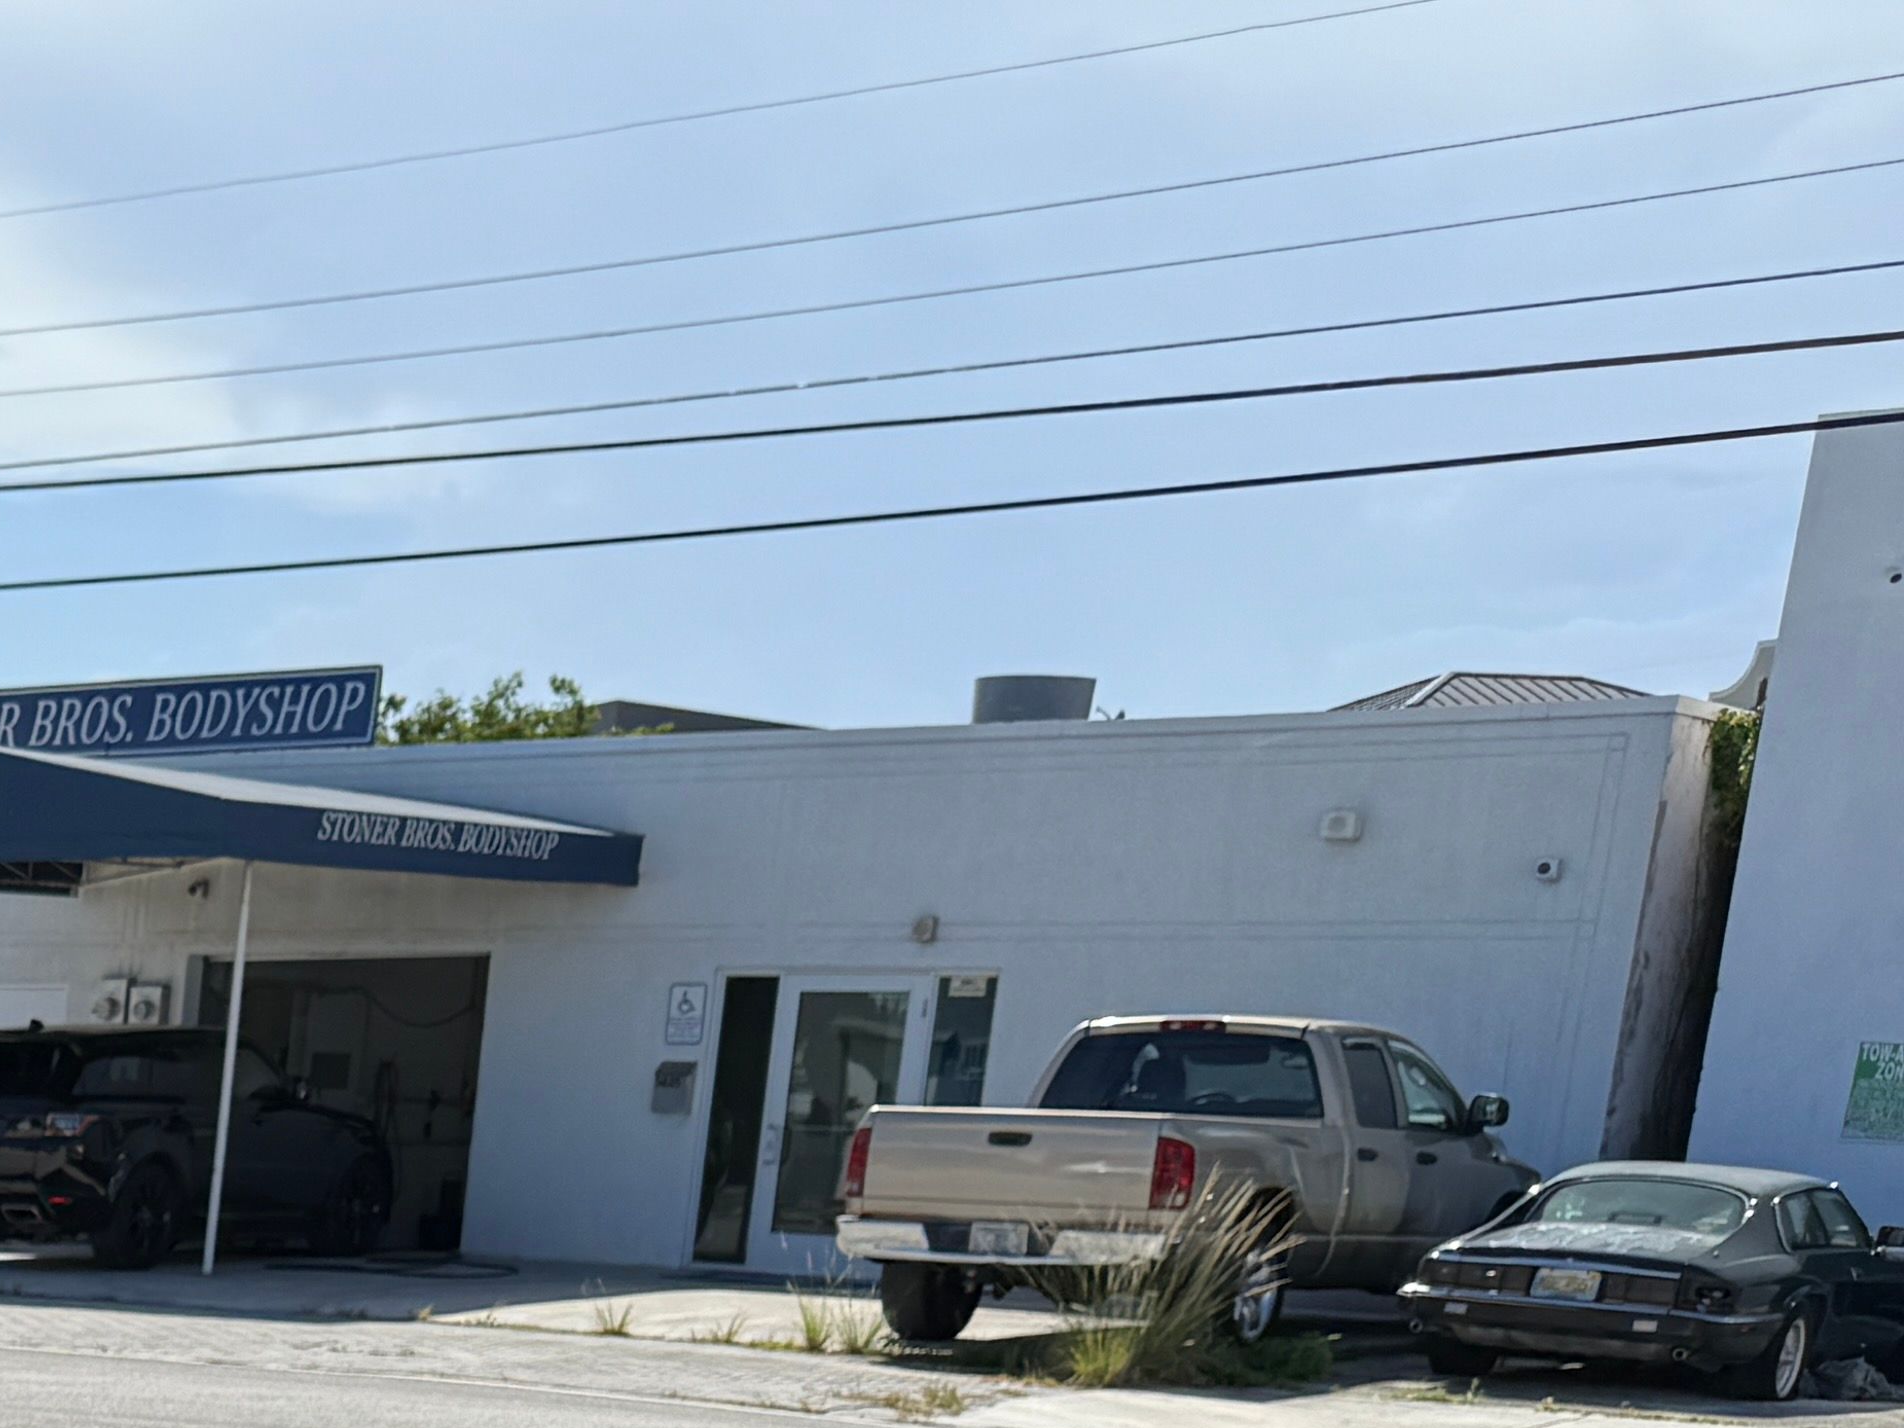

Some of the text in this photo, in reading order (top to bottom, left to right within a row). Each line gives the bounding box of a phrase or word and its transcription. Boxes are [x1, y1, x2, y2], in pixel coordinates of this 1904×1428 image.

[29, 694, 133, 748] BROS.
[146, 680, 367, 743] BODYSHOP
[317, 811, 560, 861] STONER BROS. BODYSHOP
